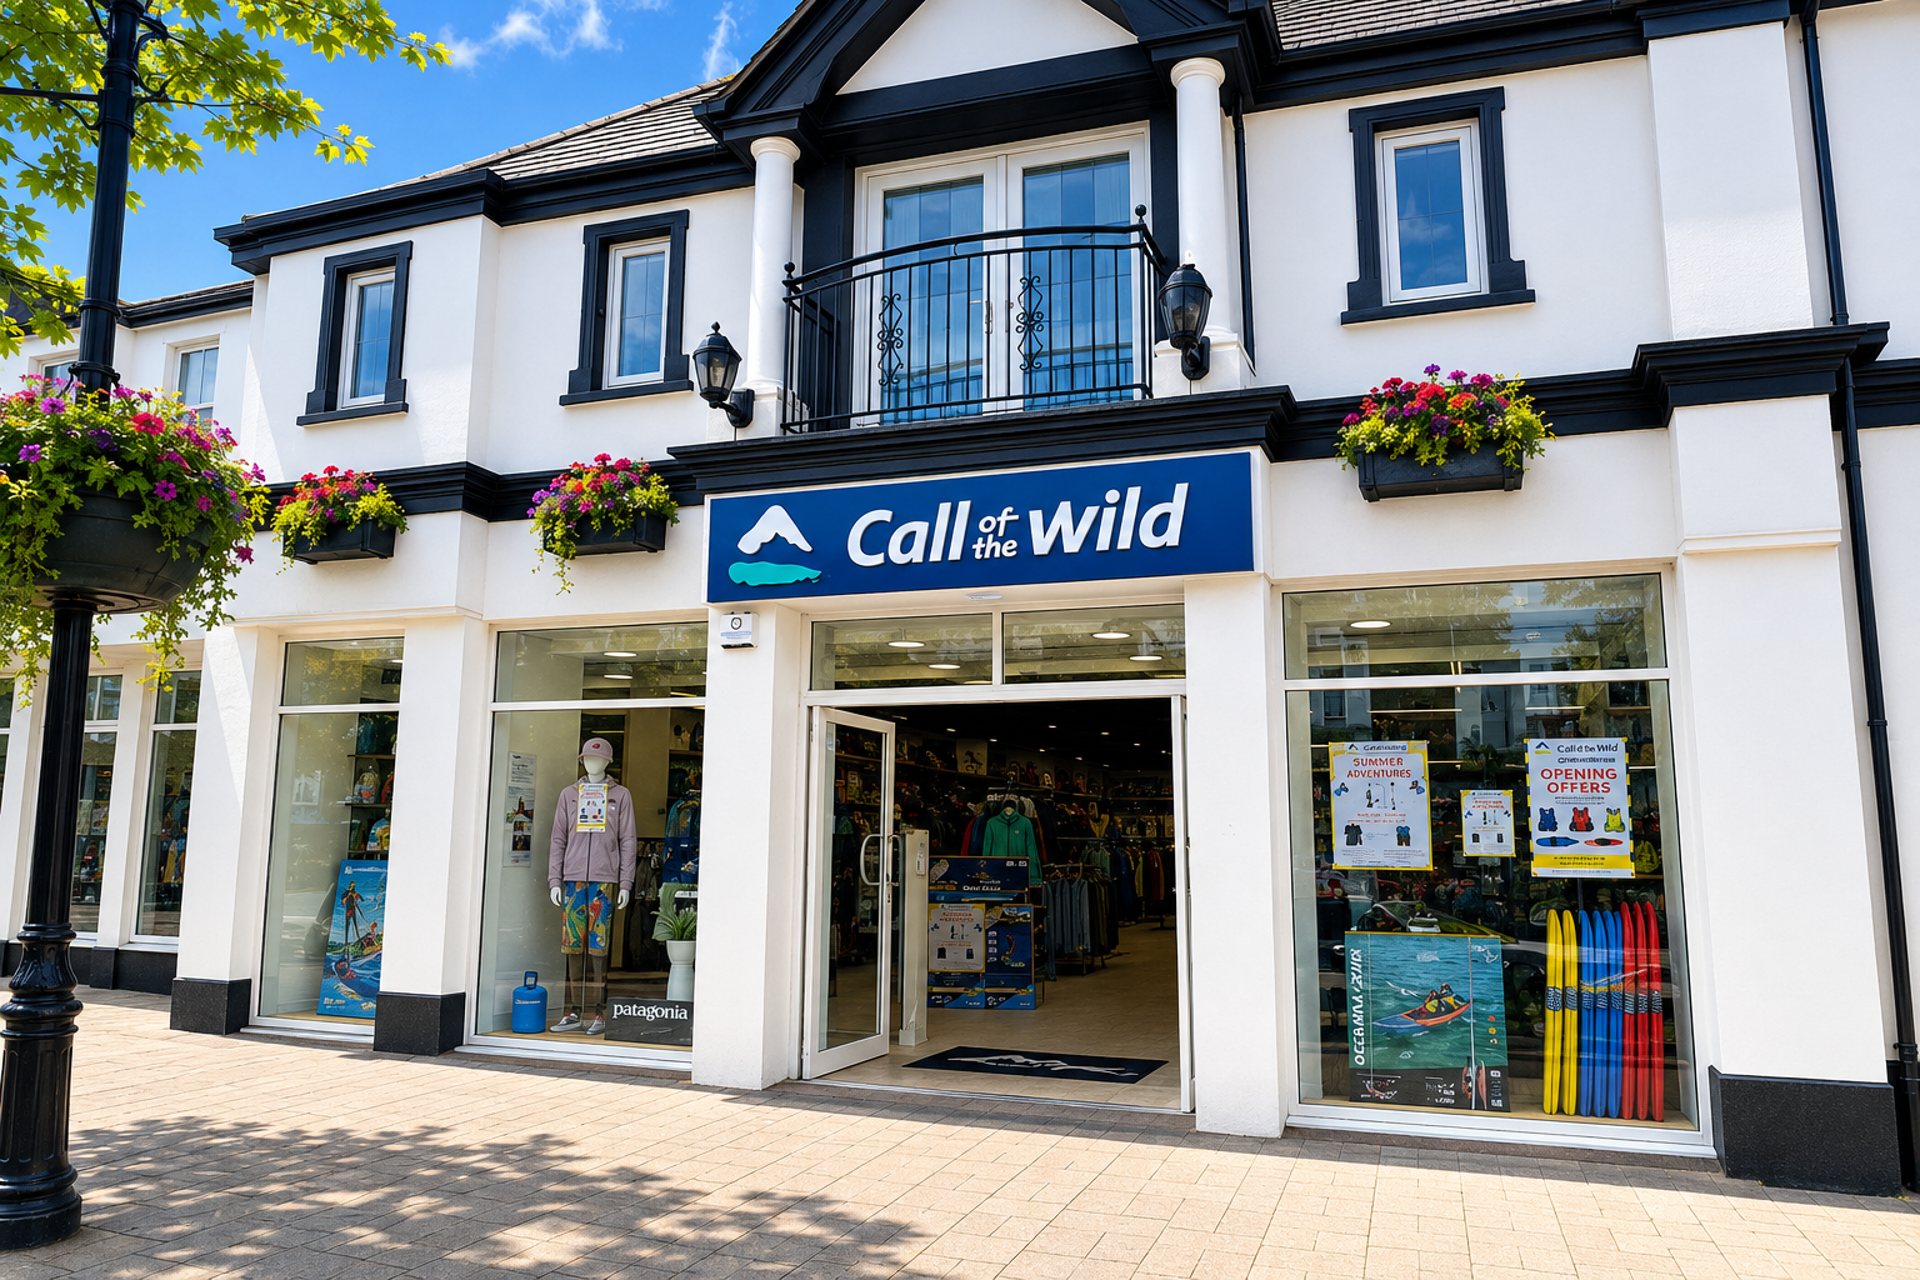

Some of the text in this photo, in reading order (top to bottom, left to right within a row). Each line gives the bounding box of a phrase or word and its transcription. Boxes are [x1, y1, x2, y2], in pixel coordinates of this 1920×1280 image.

[846, 483, 1190, 567] Call of the Wild
[1352, 757, 1404, 767] SUMMER
[1346, 769, 1412, 779] ADVENTURES
[1540, 768, 1617, 780] OPENING
[1546, 782, 1611, 793] OFFERS
[612, 1003, 688, 1022] patagonia
